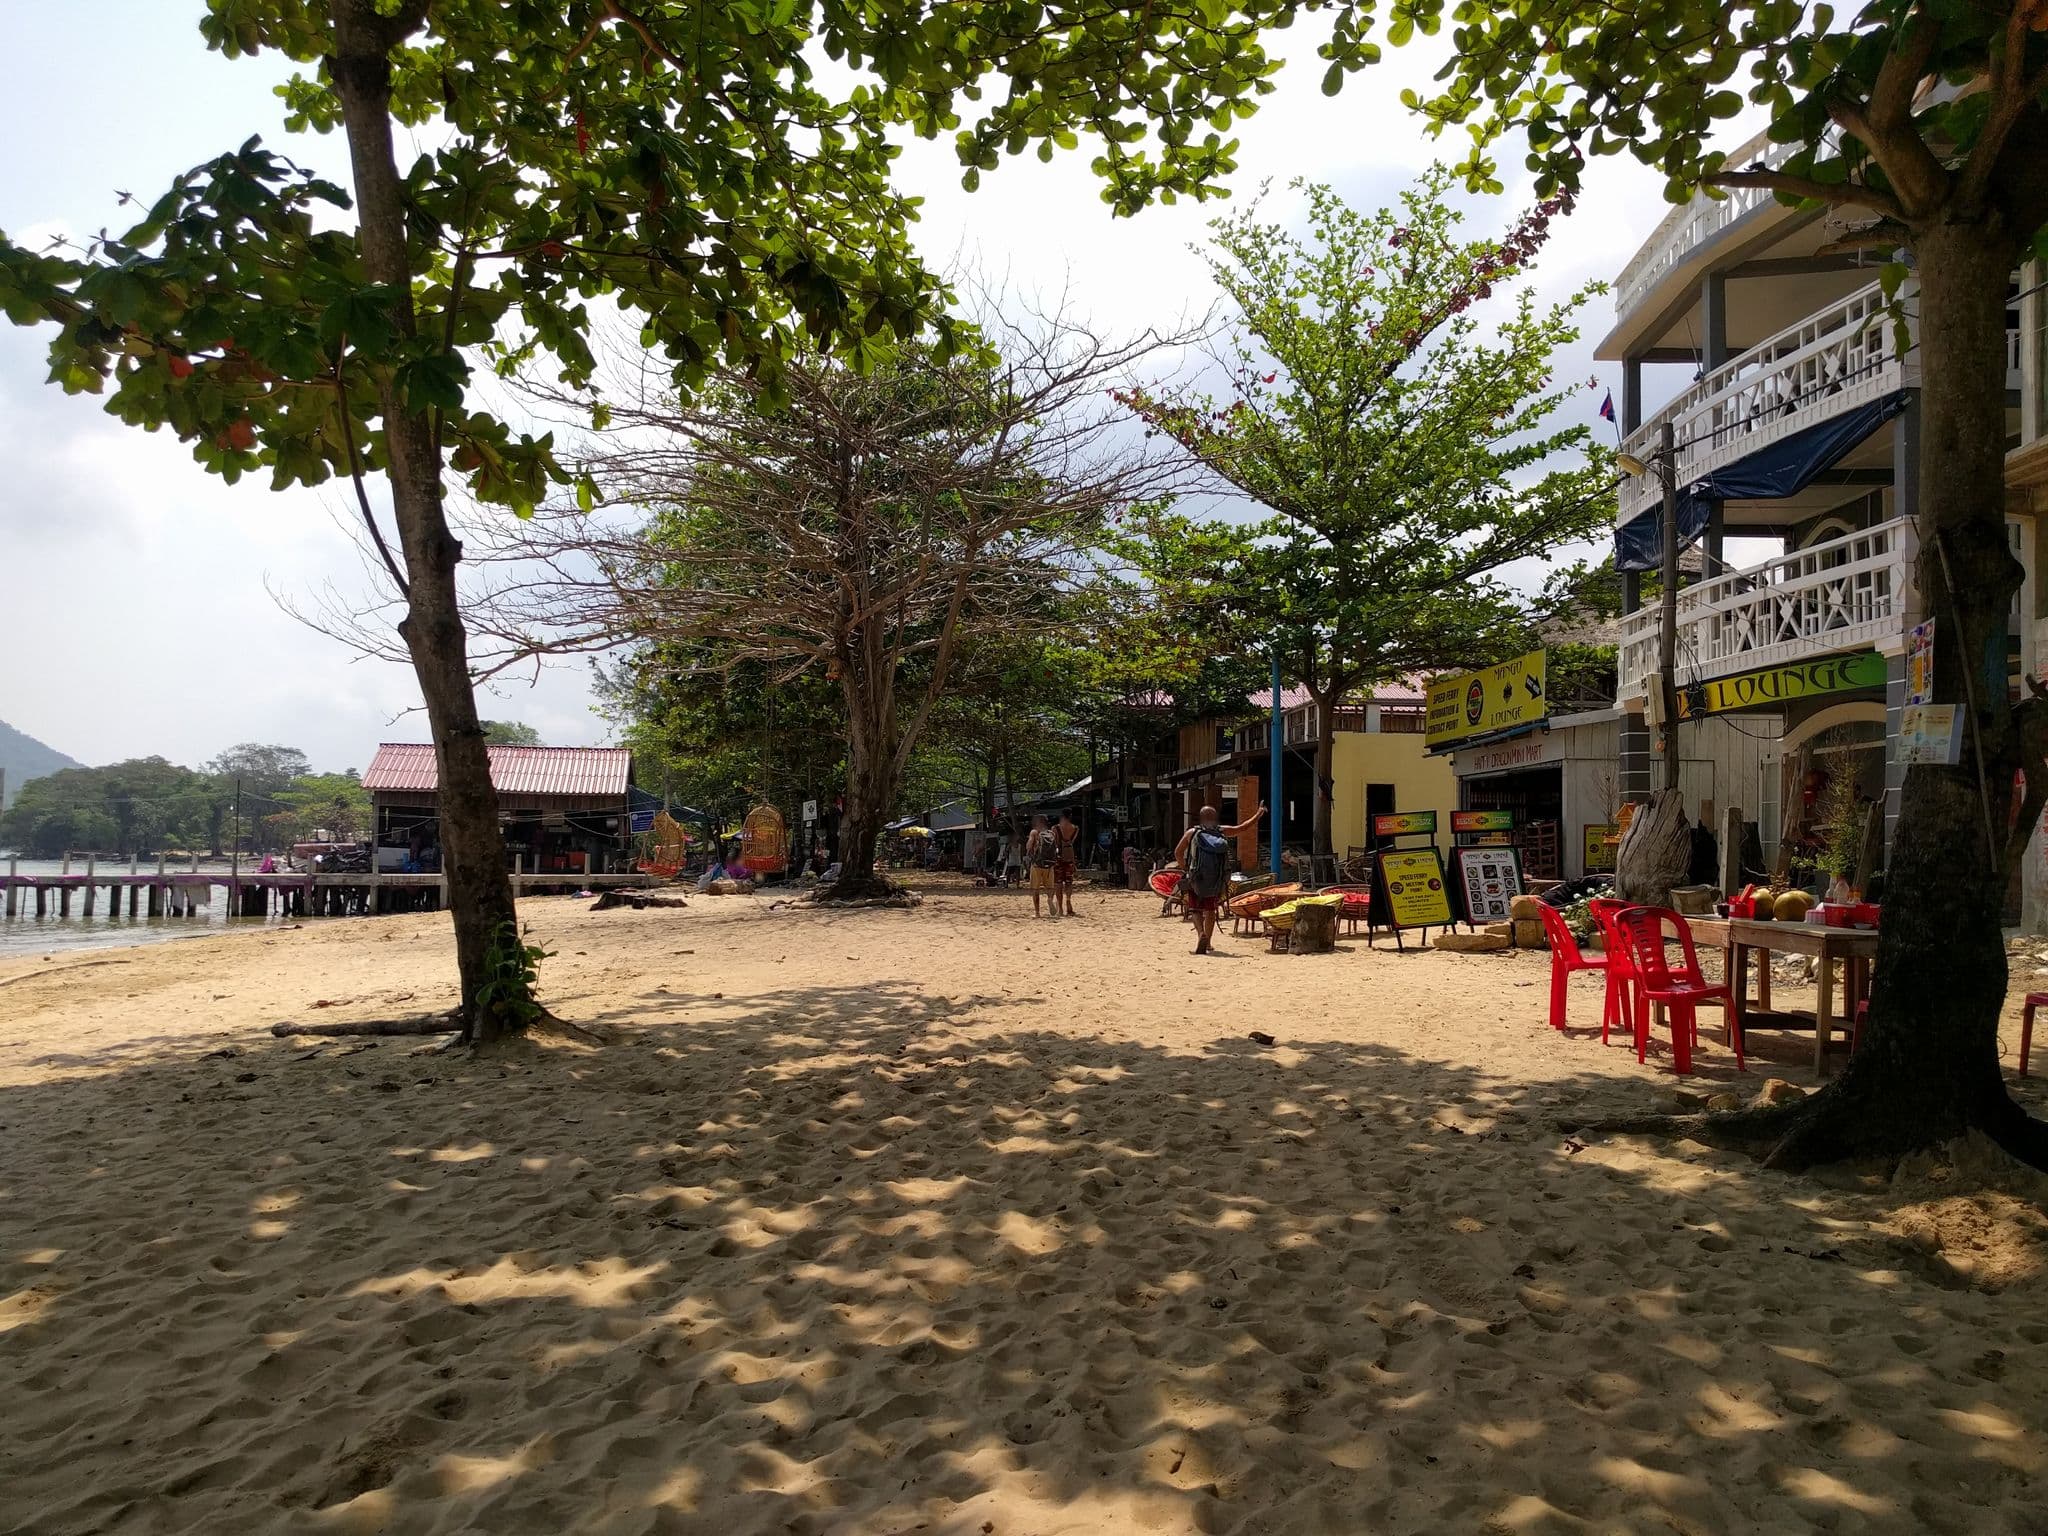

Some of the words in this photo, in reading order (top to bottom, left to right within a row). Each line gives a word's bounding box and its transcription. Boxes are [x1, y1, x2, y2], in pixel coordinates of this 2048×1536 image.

[1494, 661, 1522, 680] MANGO
[1716, 657, 1865, 708] LOUNGE
[1490, 706, 1522, 726] LOUNGE
[1526, 744, 1543, 760] MART
